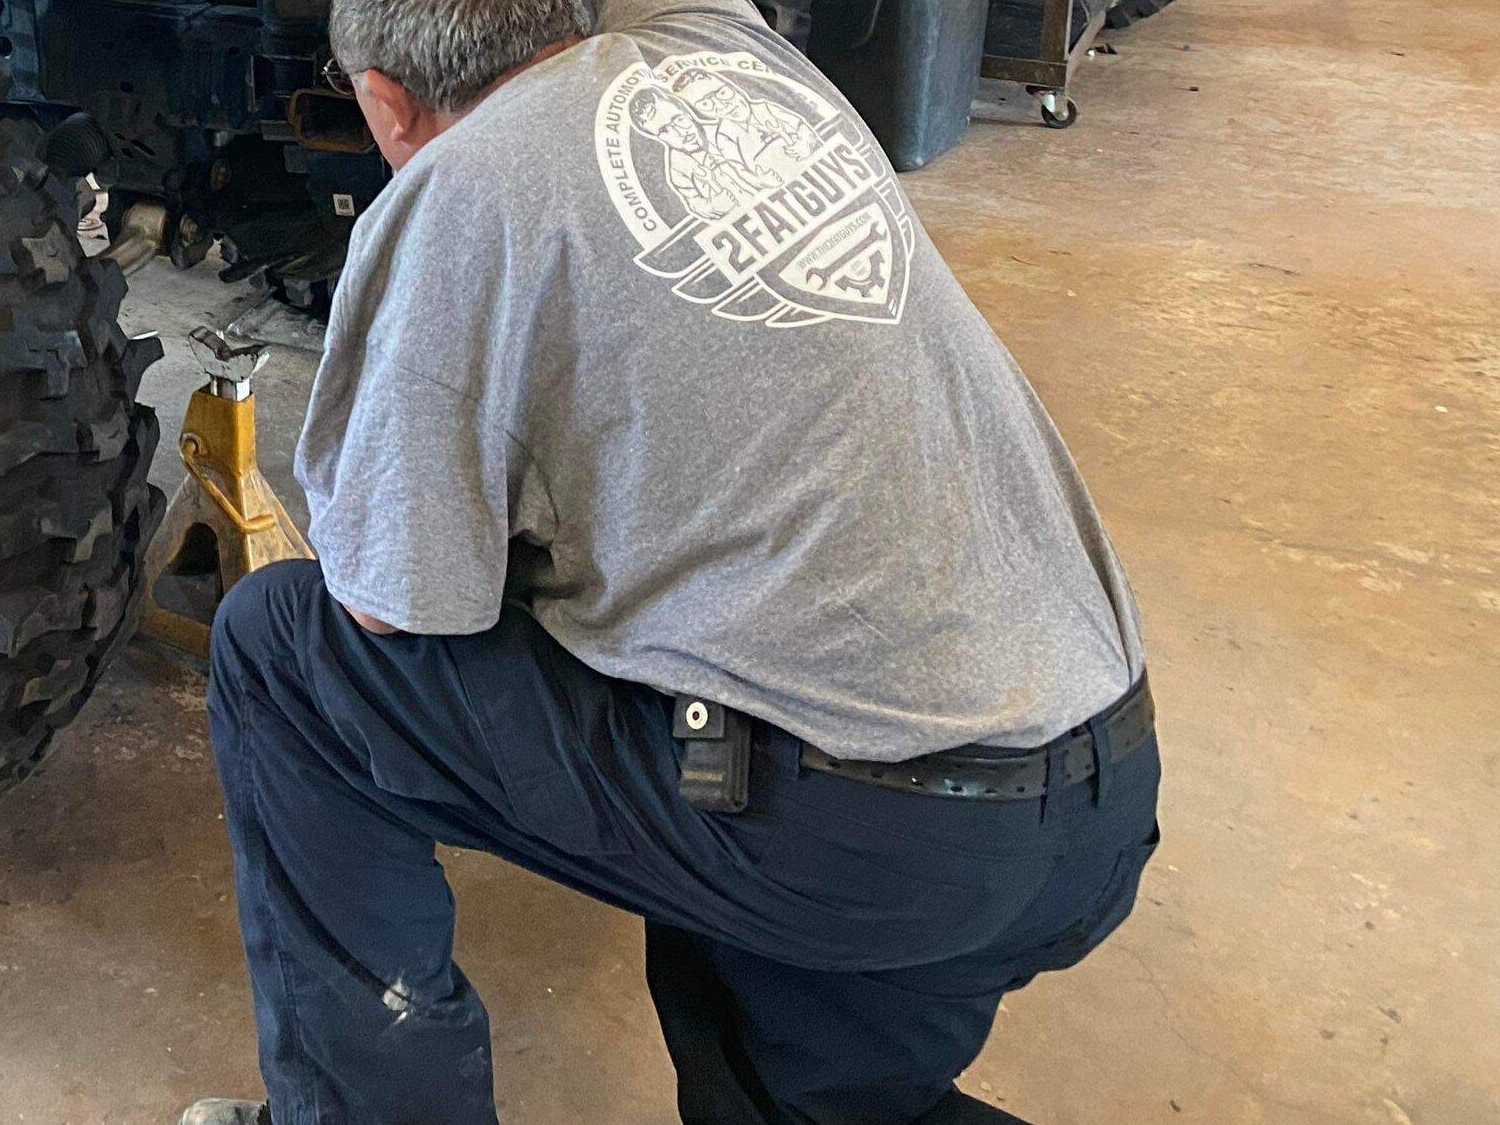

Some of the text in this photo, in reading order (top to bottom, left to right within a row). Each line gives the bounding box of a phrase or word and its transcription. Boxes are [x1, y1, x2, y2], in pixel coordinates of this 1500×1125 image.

[606, 137, 657, 232] COMPLETE
[656, 56, 733, 83] SERVICE
[711, 143, 872, 275] 2FATGUYS
